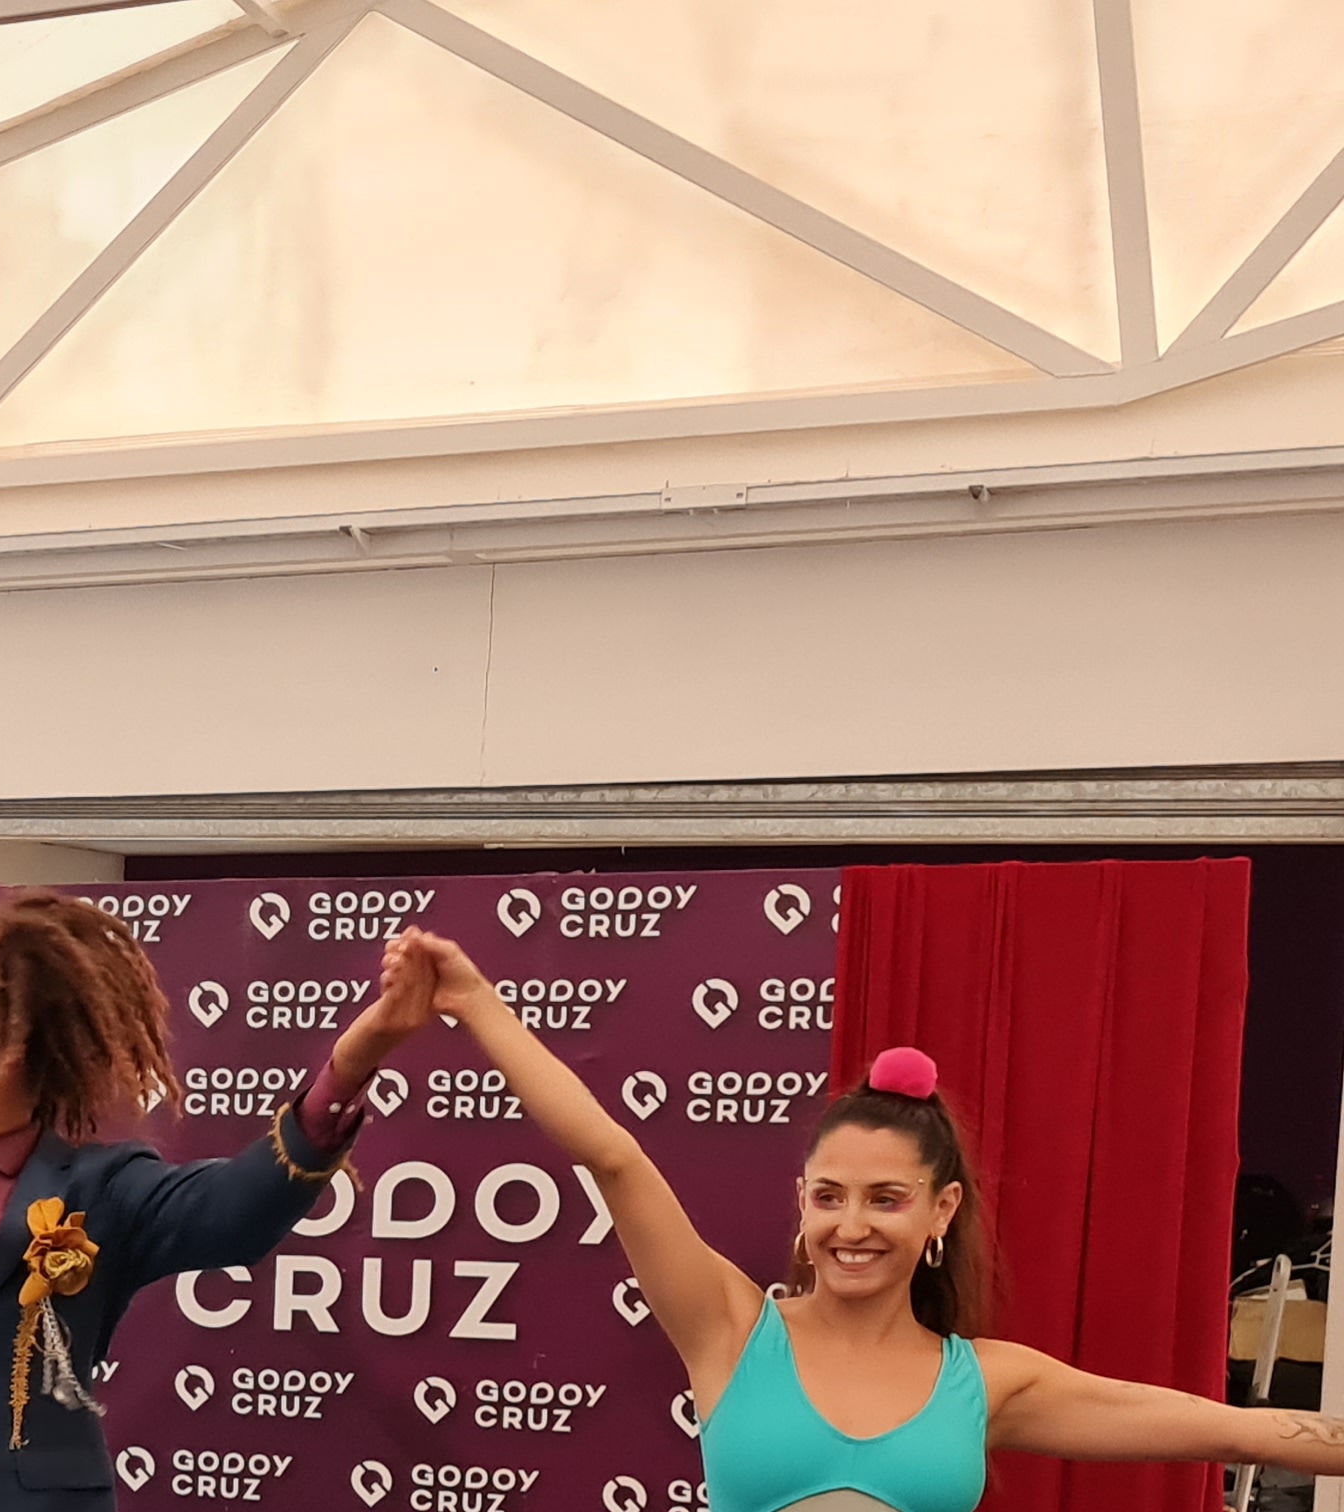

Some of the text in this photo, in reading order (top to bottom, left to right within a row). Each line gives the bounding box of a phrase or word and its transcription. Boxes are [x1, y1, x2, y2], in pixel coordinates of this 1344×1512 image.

[78, 894, 193, 918] ODOY
[308, 889, 436, 914] GODOY
[561, 885, 697, 910] GODOY
[308, 917, 403, 941] CRUZ
[559, 913, 661, 938] CRUZ
[247, 980, 372, 1003] GODOY
[494, 978, 628, 1003] GODOY
[759, 977, 835, 1002] GOD
[246, 1006, 339, 1029] CRUZ
[505, 1005, 592, 1030] RUZ
[758, 1005, 834, 1030] CRU
[185, 1067, 308, 1091] GODOY
[427, 1069, 507, 1093] GOD
[688, 1071, 828, 1096] GODOY
[184, 1092, 275, 1116] CRUZ
[426, 1095, 523, 1119] CRUZ
[686, 1099, 790, 1123] CRUZ
[291, 1161, 614, 1245] ODOY
[175, 1255, 520, 1341] CRUZ
[232, 1367, 355, 1394] GODOY
[231, 1392, 323, 1419] CRUZ
[475, 1379, 607, 1408] GODOY
[474, 1405, 572, 1433] CRUZ
[172, 1449, 293, 1477] GODOY
[171, 1474, 262, 1501] CRUZ
[411, 1463, 540, 1493] GODOY
